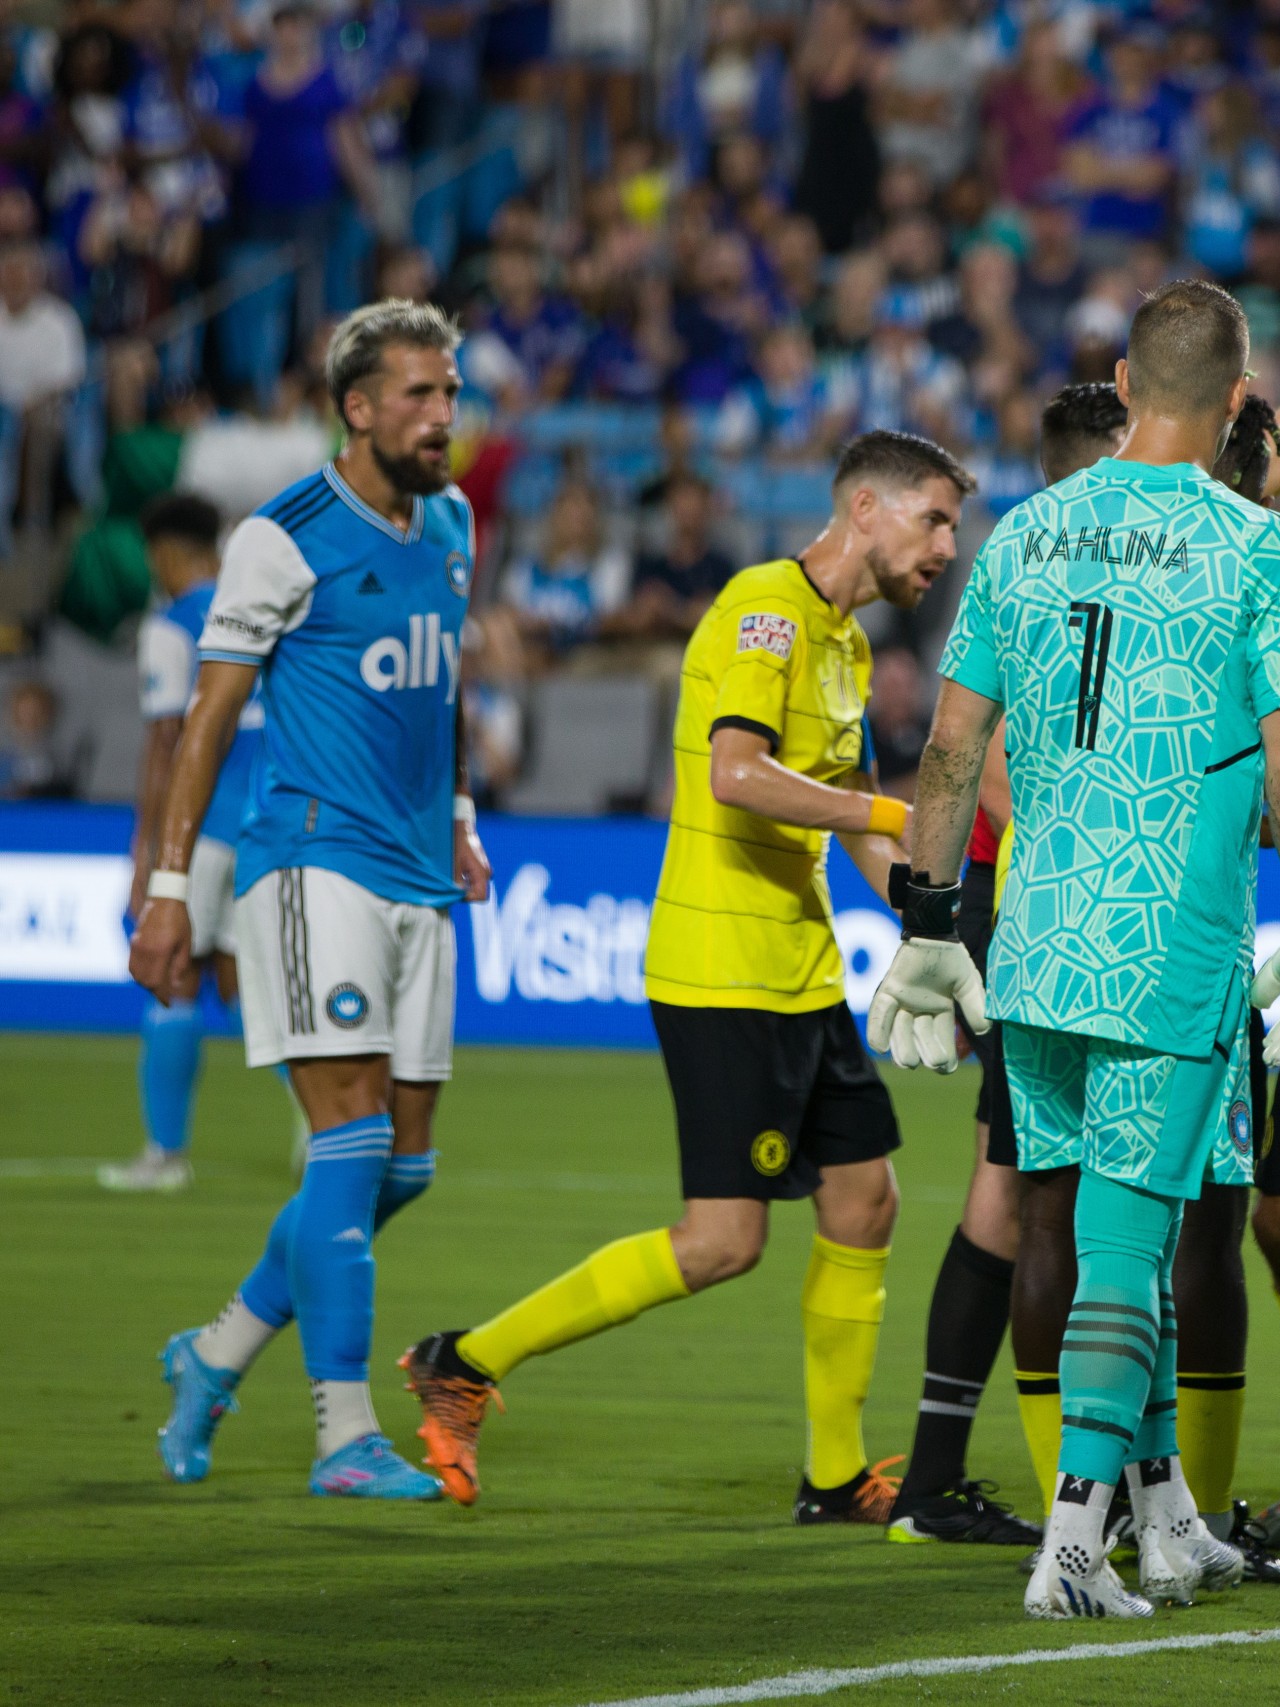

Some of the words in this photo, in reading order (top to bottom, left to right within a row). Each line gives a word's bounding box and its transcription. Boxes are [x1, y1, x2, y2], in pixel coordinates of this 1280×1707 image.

[1023, 526, 1189, 574] KAHLINA
[739, 631, 790, 660] TOUR
[753, 615, 796, 641] USA
[360, 612, 460, 705] ally
[1068, 601, 1114, 752] 1
